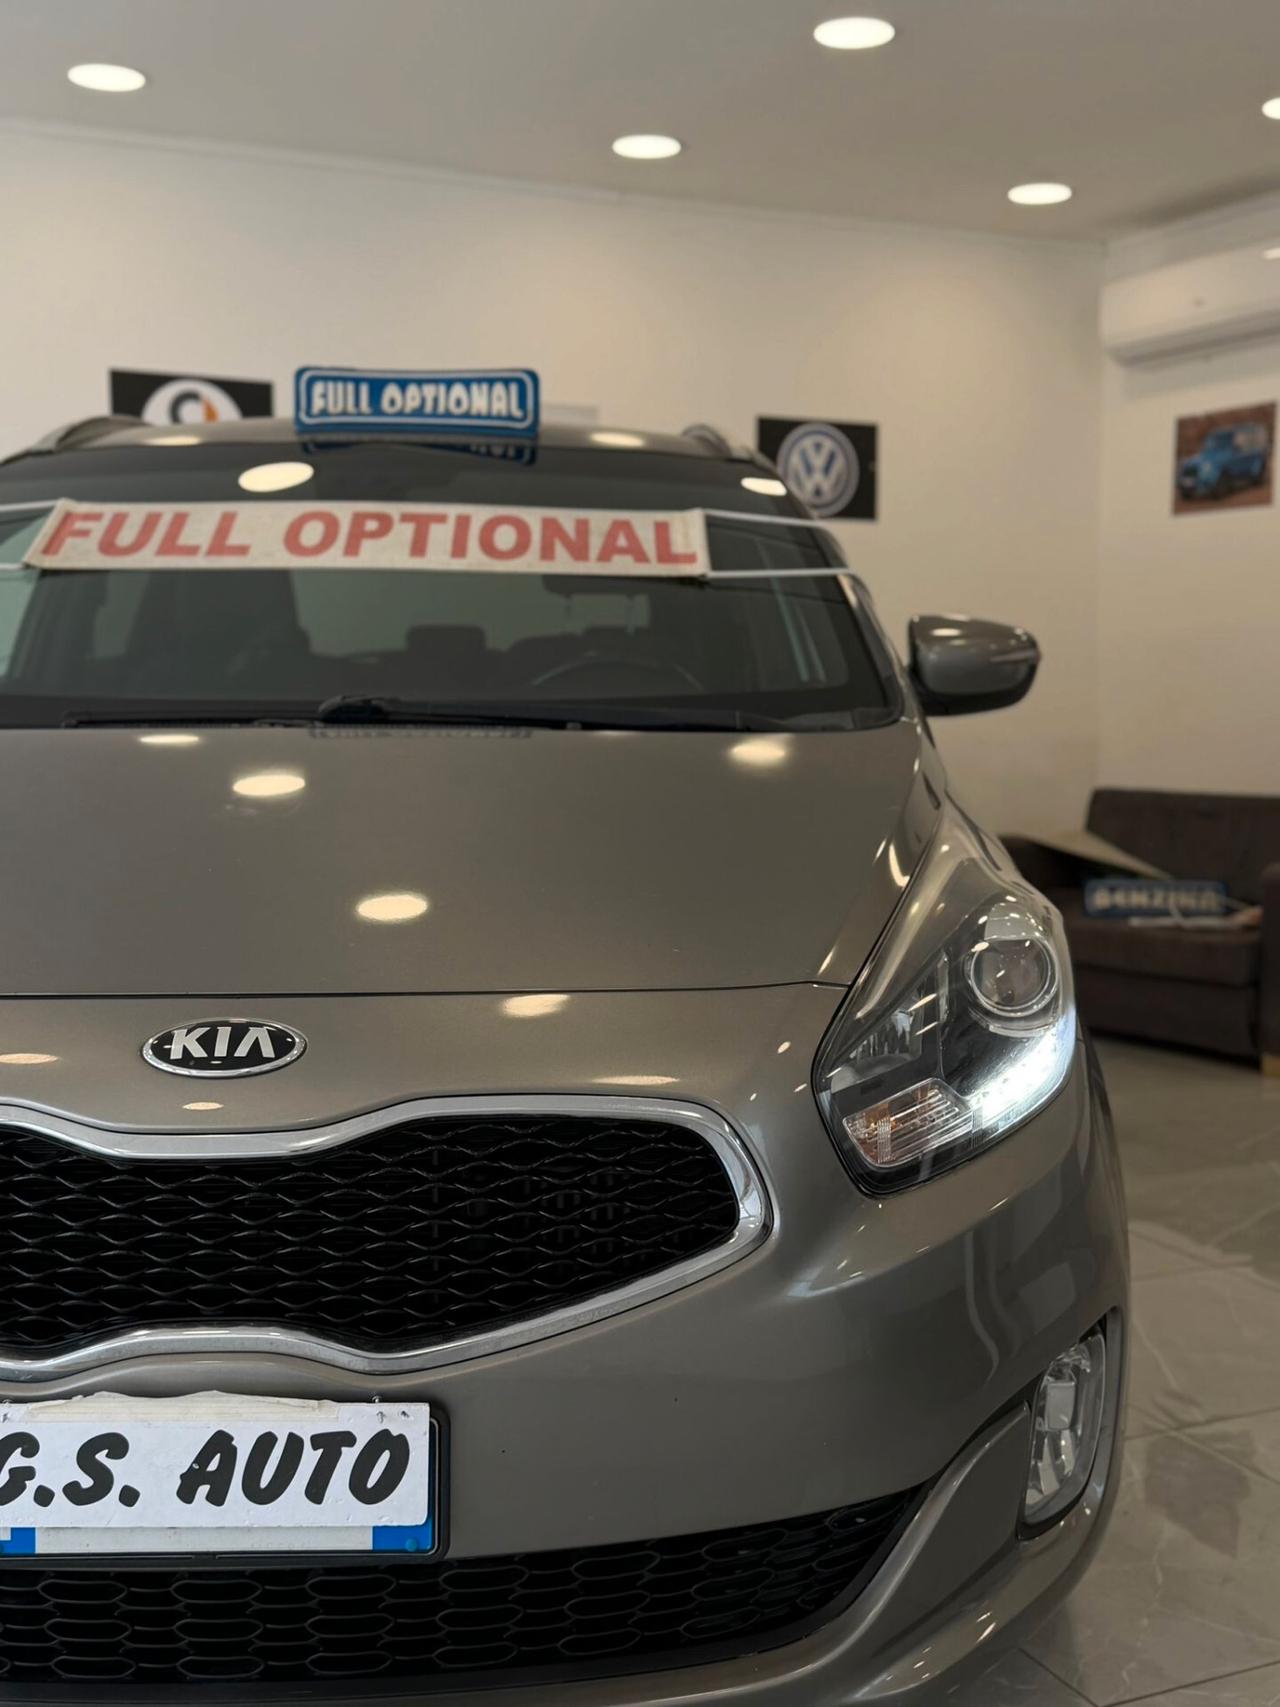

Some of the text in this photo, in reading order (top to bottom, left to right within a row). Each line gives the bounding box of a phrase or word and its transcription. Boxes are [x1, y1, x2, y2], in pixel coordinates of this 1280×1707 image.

[311, 381, 524, 419] FULL OPTIONAL
[42, 511, 697, 564] FULL OPTIONAL
[170, 1026, 276, 1060] KIA
[176, 1429, 410, 1507] AUTO
